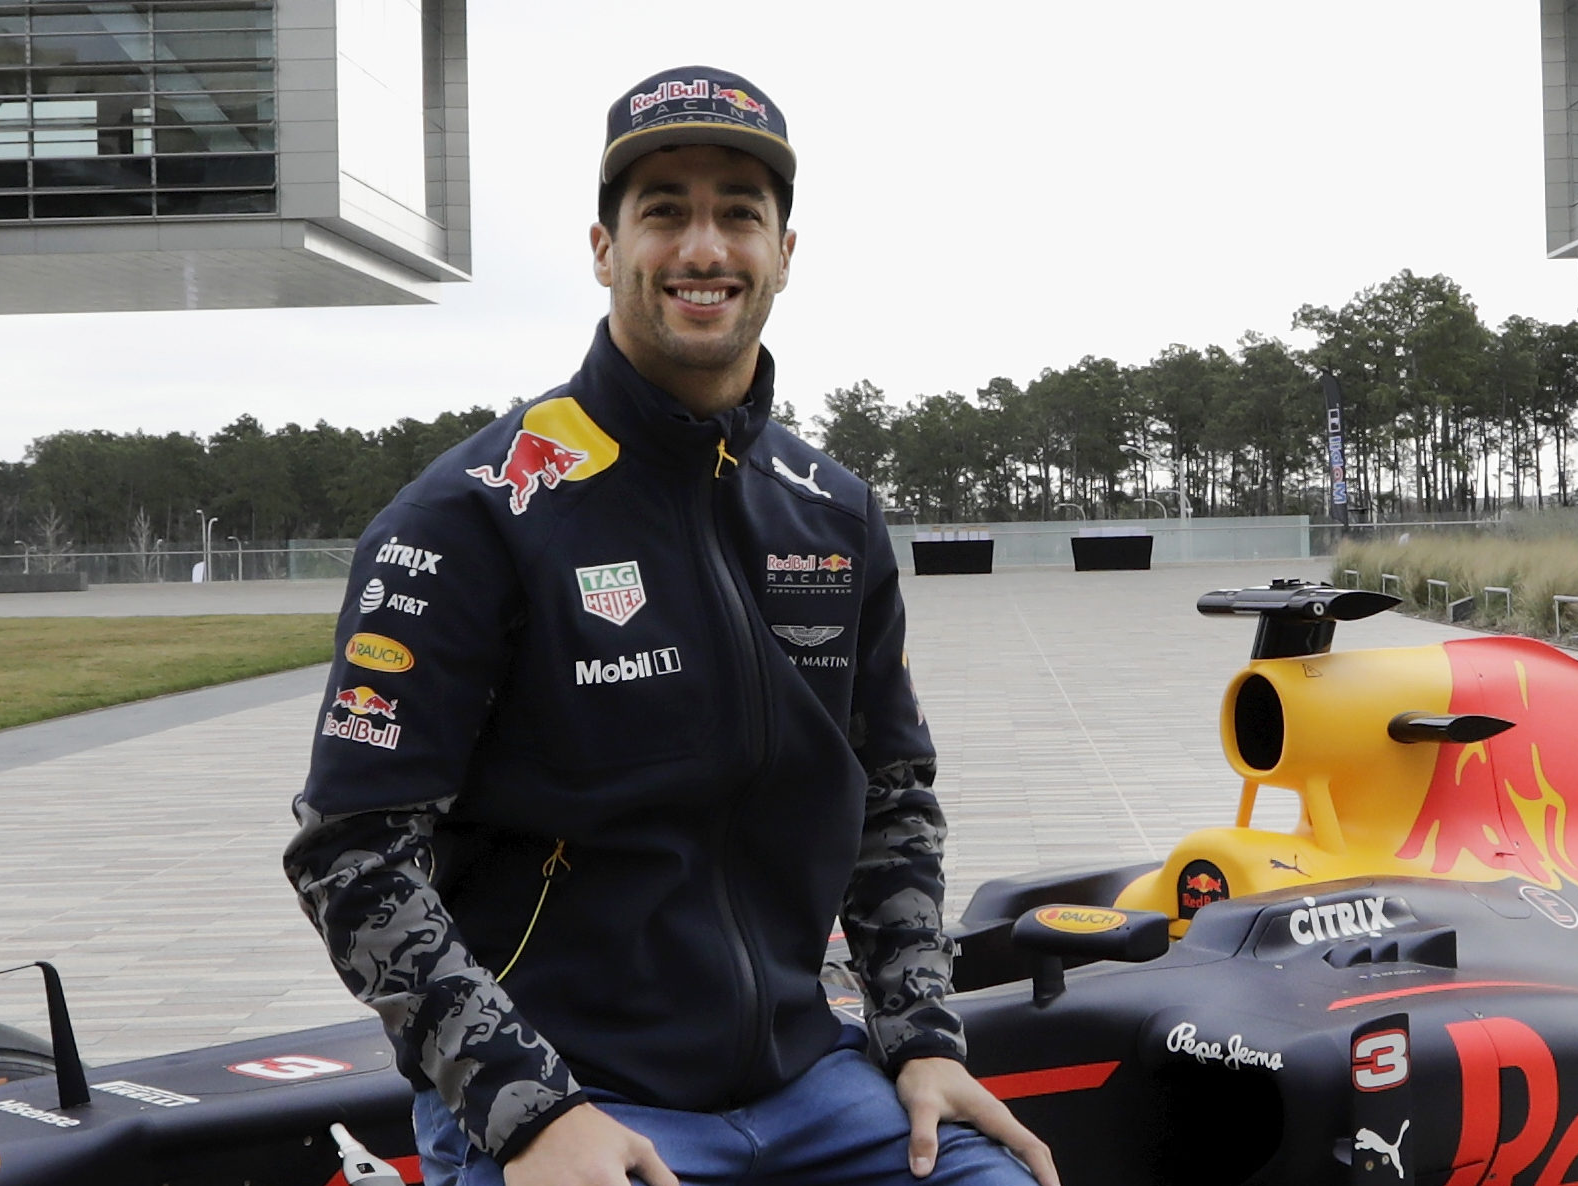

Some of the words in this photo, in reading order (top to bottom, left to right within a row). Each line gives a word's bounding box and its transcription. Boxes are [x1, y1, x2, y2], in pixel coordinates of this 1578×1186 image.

[632, 101, 768, 130] RACING
[582, 566, 636, 589] TAG
[766, 573, 852, 583] RACING
[386, 593, 429, 616] AT&T
[586, 588, 642, 620] HEUER
[355, 643, 404, 665] RAUCH
[575, 652, 653, 685] Mobil
[656, 649, 676, 673] 1
[802, 656, 849, 668] MARTIN
[1058, 911, 1116, 925] RAUCH
[1167, 1022, 1223, 1063] Pepe
[1224, 1034, 1283, 1071] Jeans
[232, 1054, 350, 1080] 3
[1353, 1030, 1410, 1091] 3
[90, 1080, 200, 1107] PIRELLI
